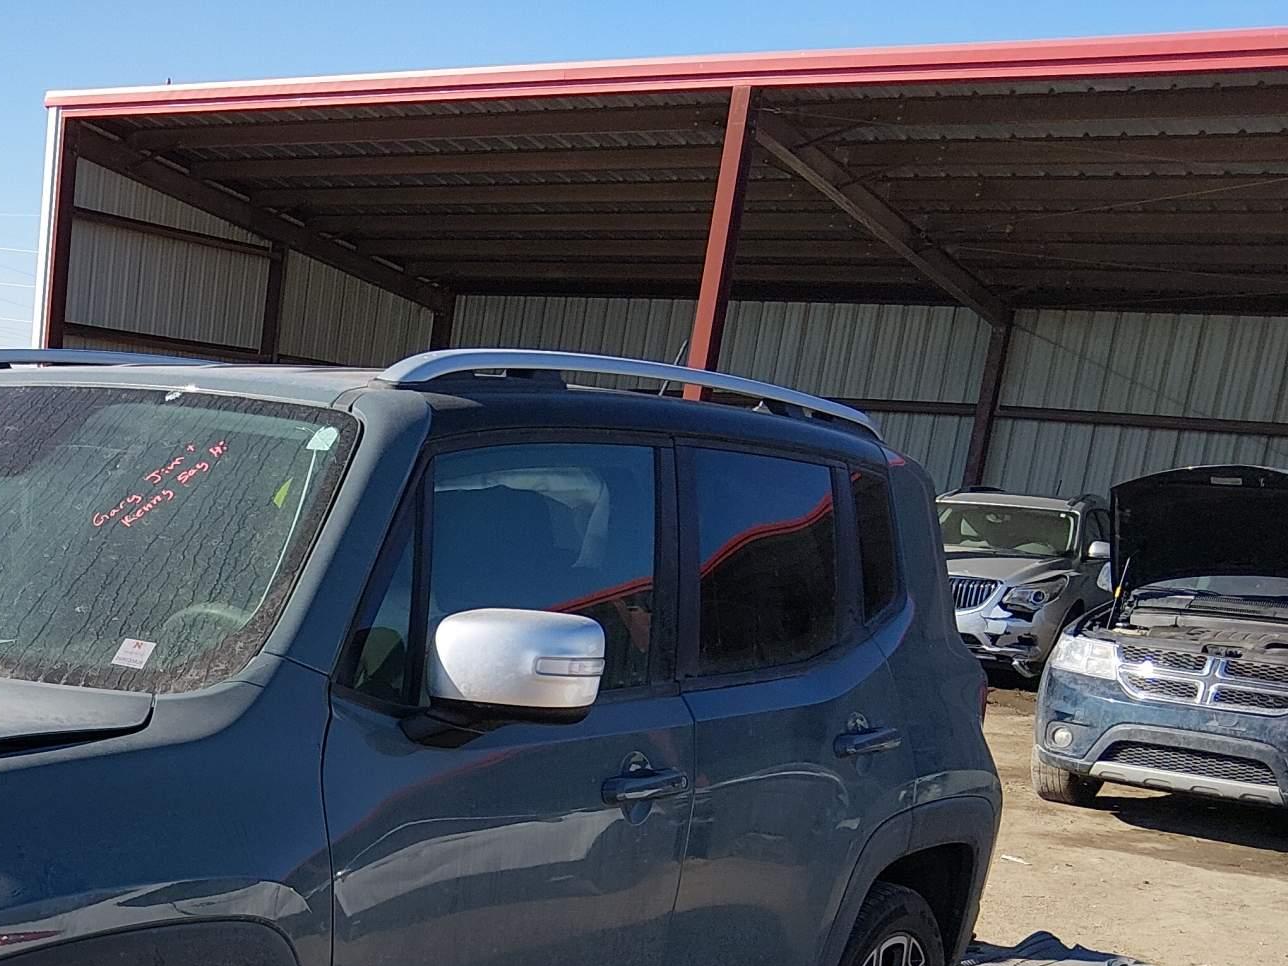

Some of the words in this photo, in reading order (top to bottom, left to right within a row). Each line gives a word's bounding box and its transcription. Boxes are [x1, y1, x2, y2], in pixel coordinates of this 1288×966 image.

[92, 494, 142, 527] Gary
[144, 456, 185, 484] Jim
[120, 488, 174, 527] Kenny
